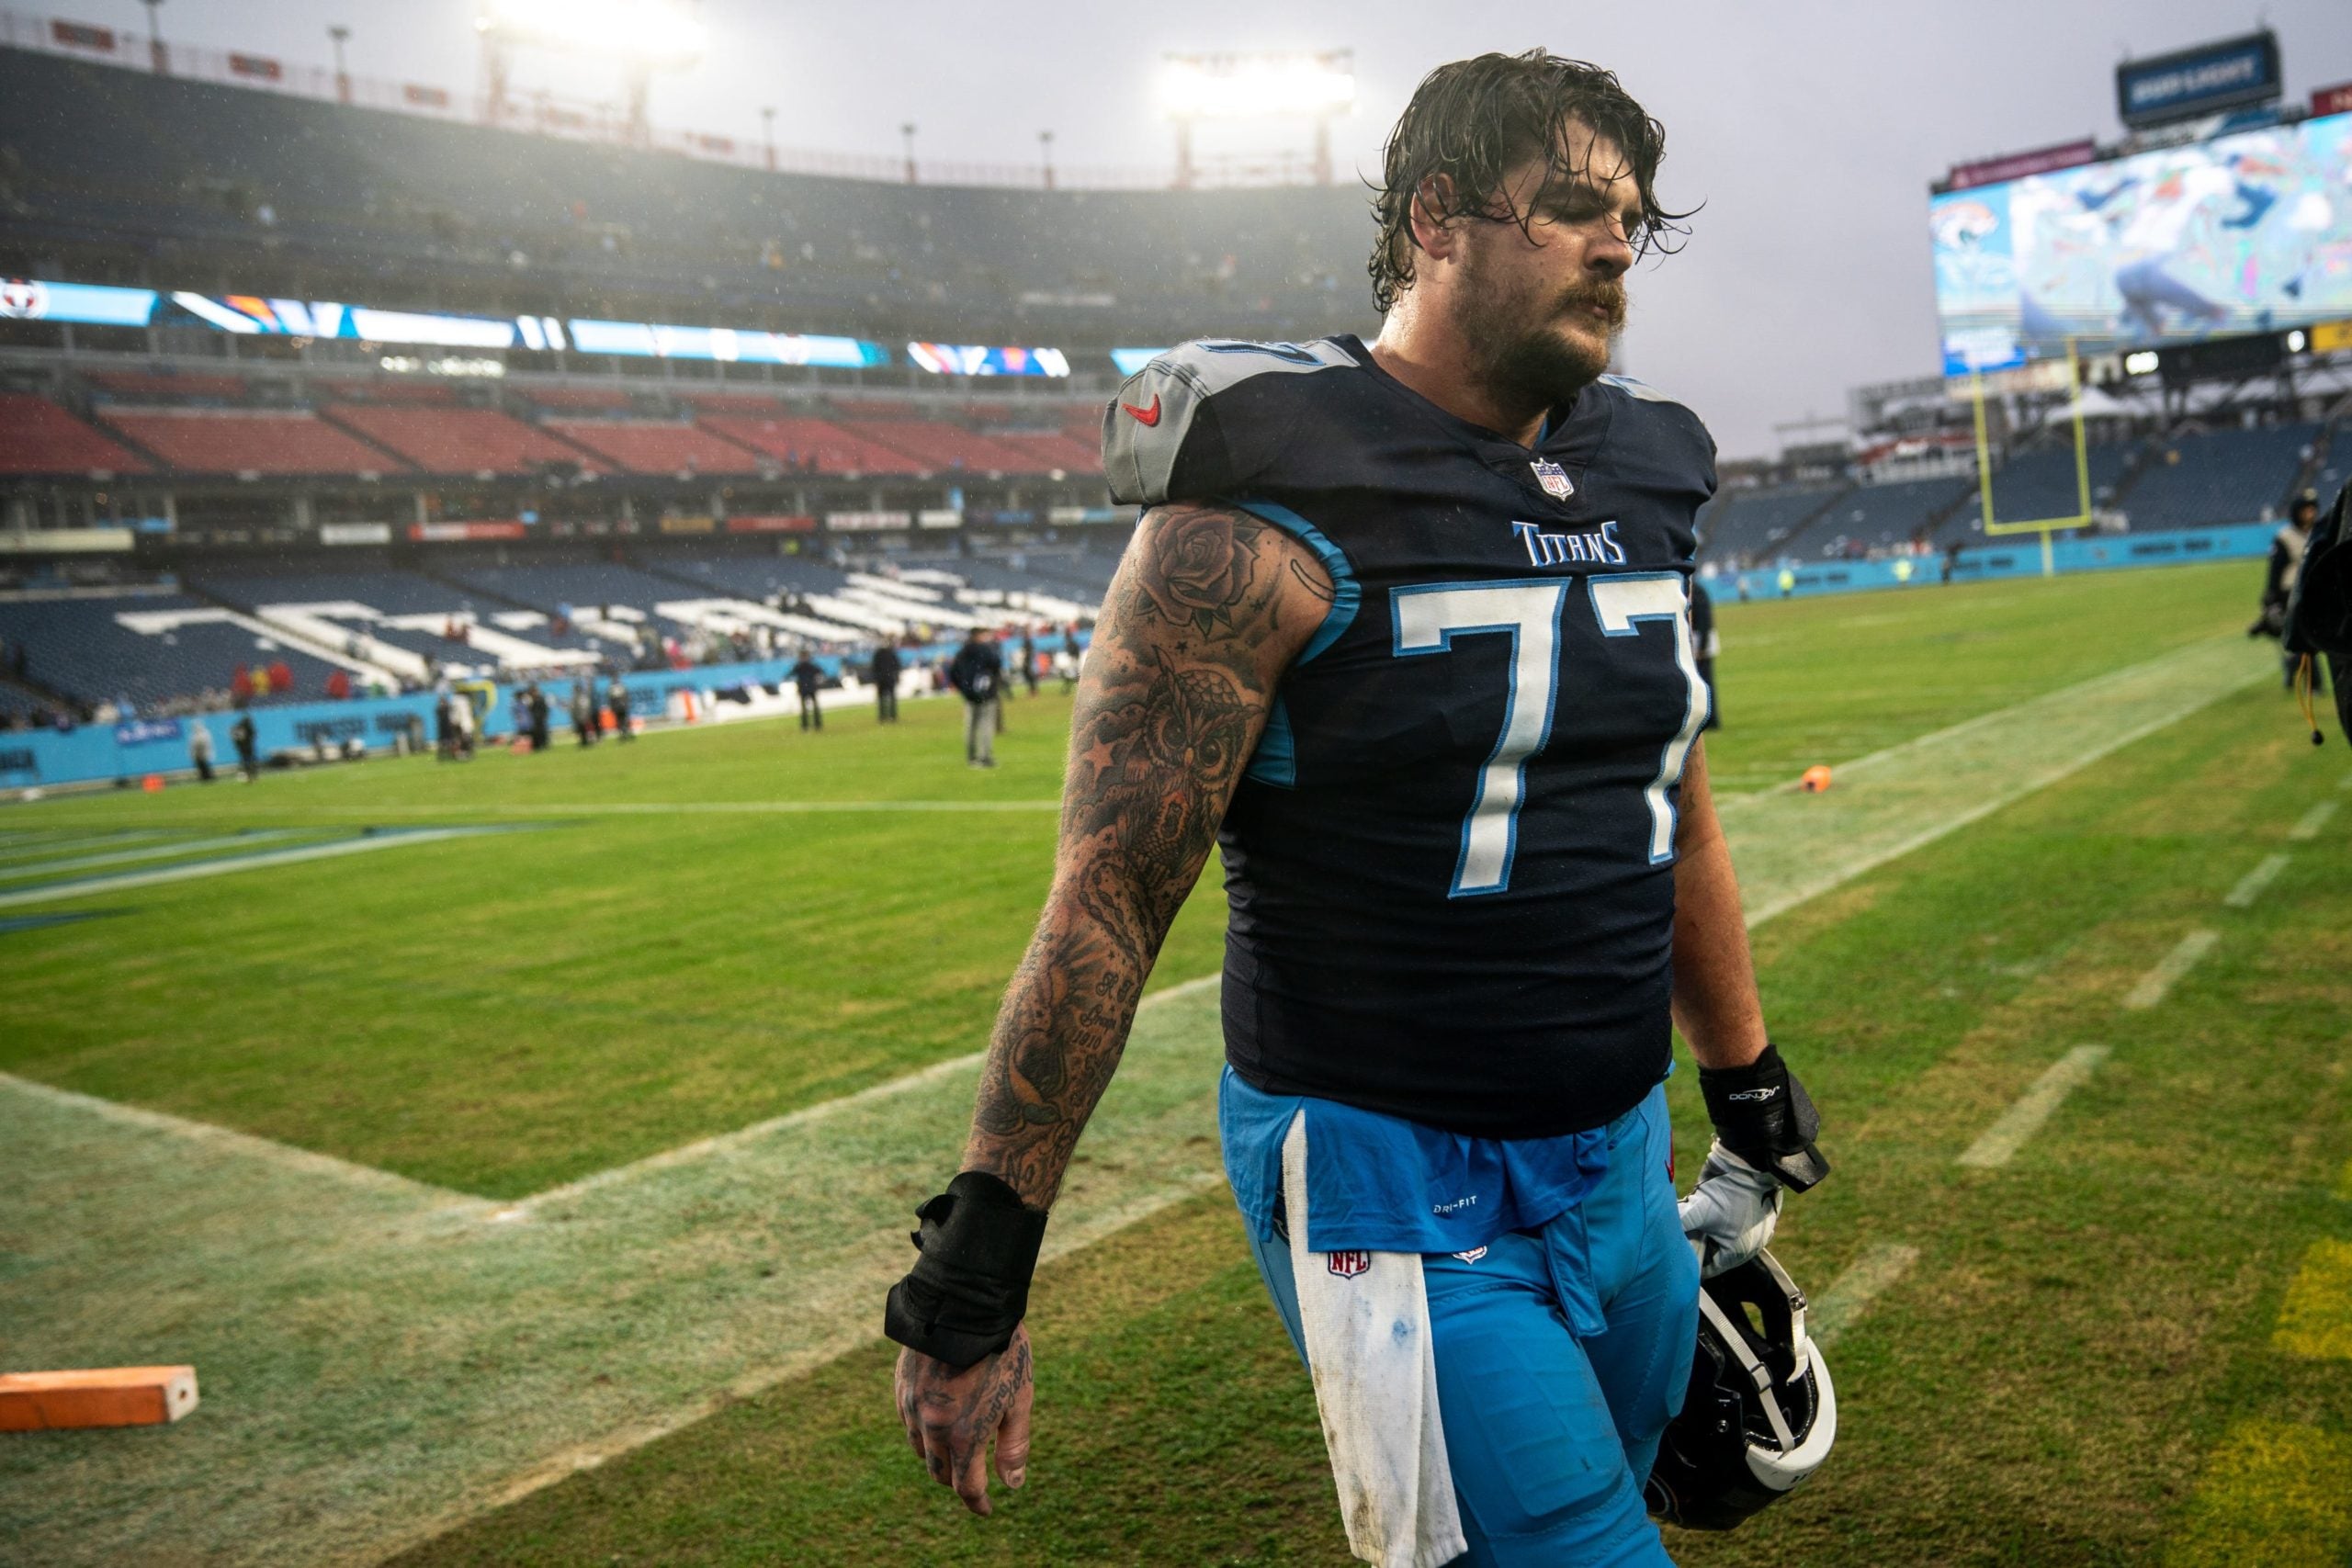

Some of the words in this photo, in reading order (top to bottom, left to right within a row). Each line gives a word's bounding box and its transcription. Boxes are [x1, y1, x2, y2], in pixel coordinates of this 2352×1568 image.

[1511, 520, 1627, 568] TITANS
[1389, 571, 1712, 899] 77
[1433, 1195, 1477, 1213] DRI-FIT
[1331, 1250, 1367, 1274] NFL
